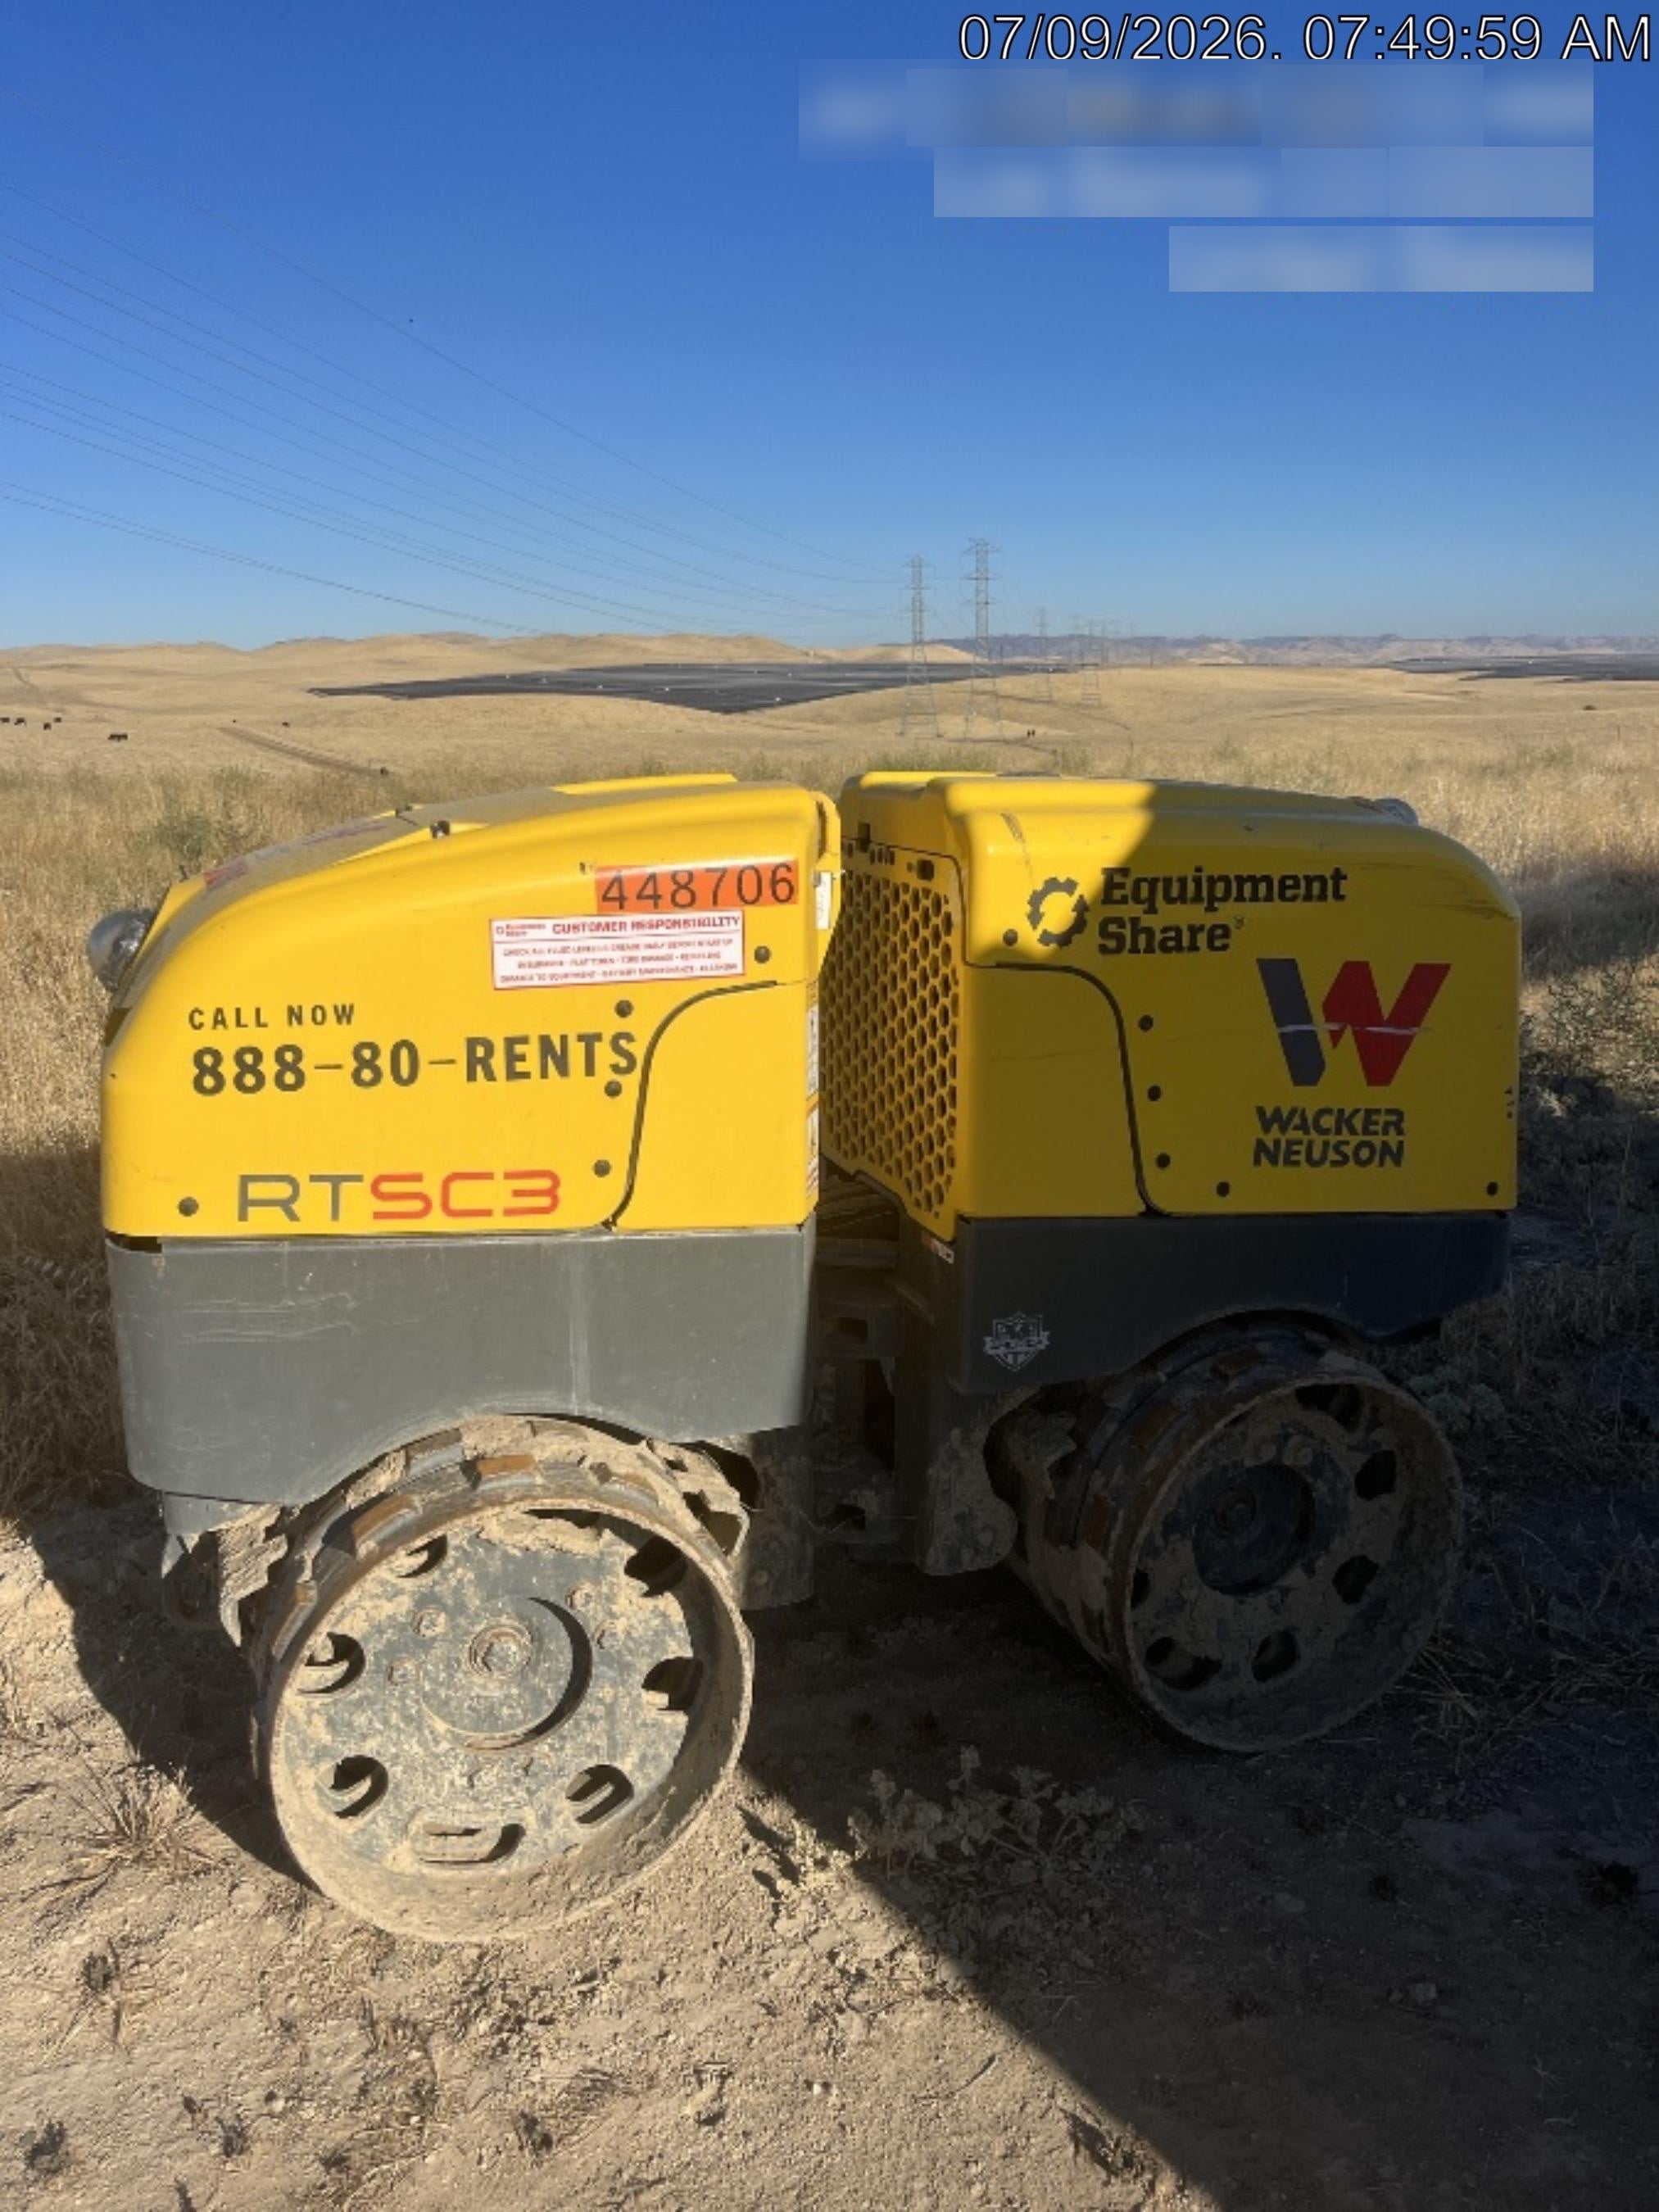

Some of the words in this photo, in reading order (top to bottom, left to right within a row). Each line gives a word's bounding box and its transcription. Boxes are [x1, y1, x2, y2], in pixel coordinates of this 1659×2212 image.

[600, 862, 796, 911] 448706
[1100, 866, 1348, 913] Equipment
[551, 921, 628, 935] CUSTOMER
[188, 1007, 269, 1031] CALL
[287, 1003, 355, 1027] NOW
[1255, 1106, 1406, 1136] WACKER
[1253, 1140, 1405, 1168] NEUSON
[237, 1169, 561, 1222] RTSC3
